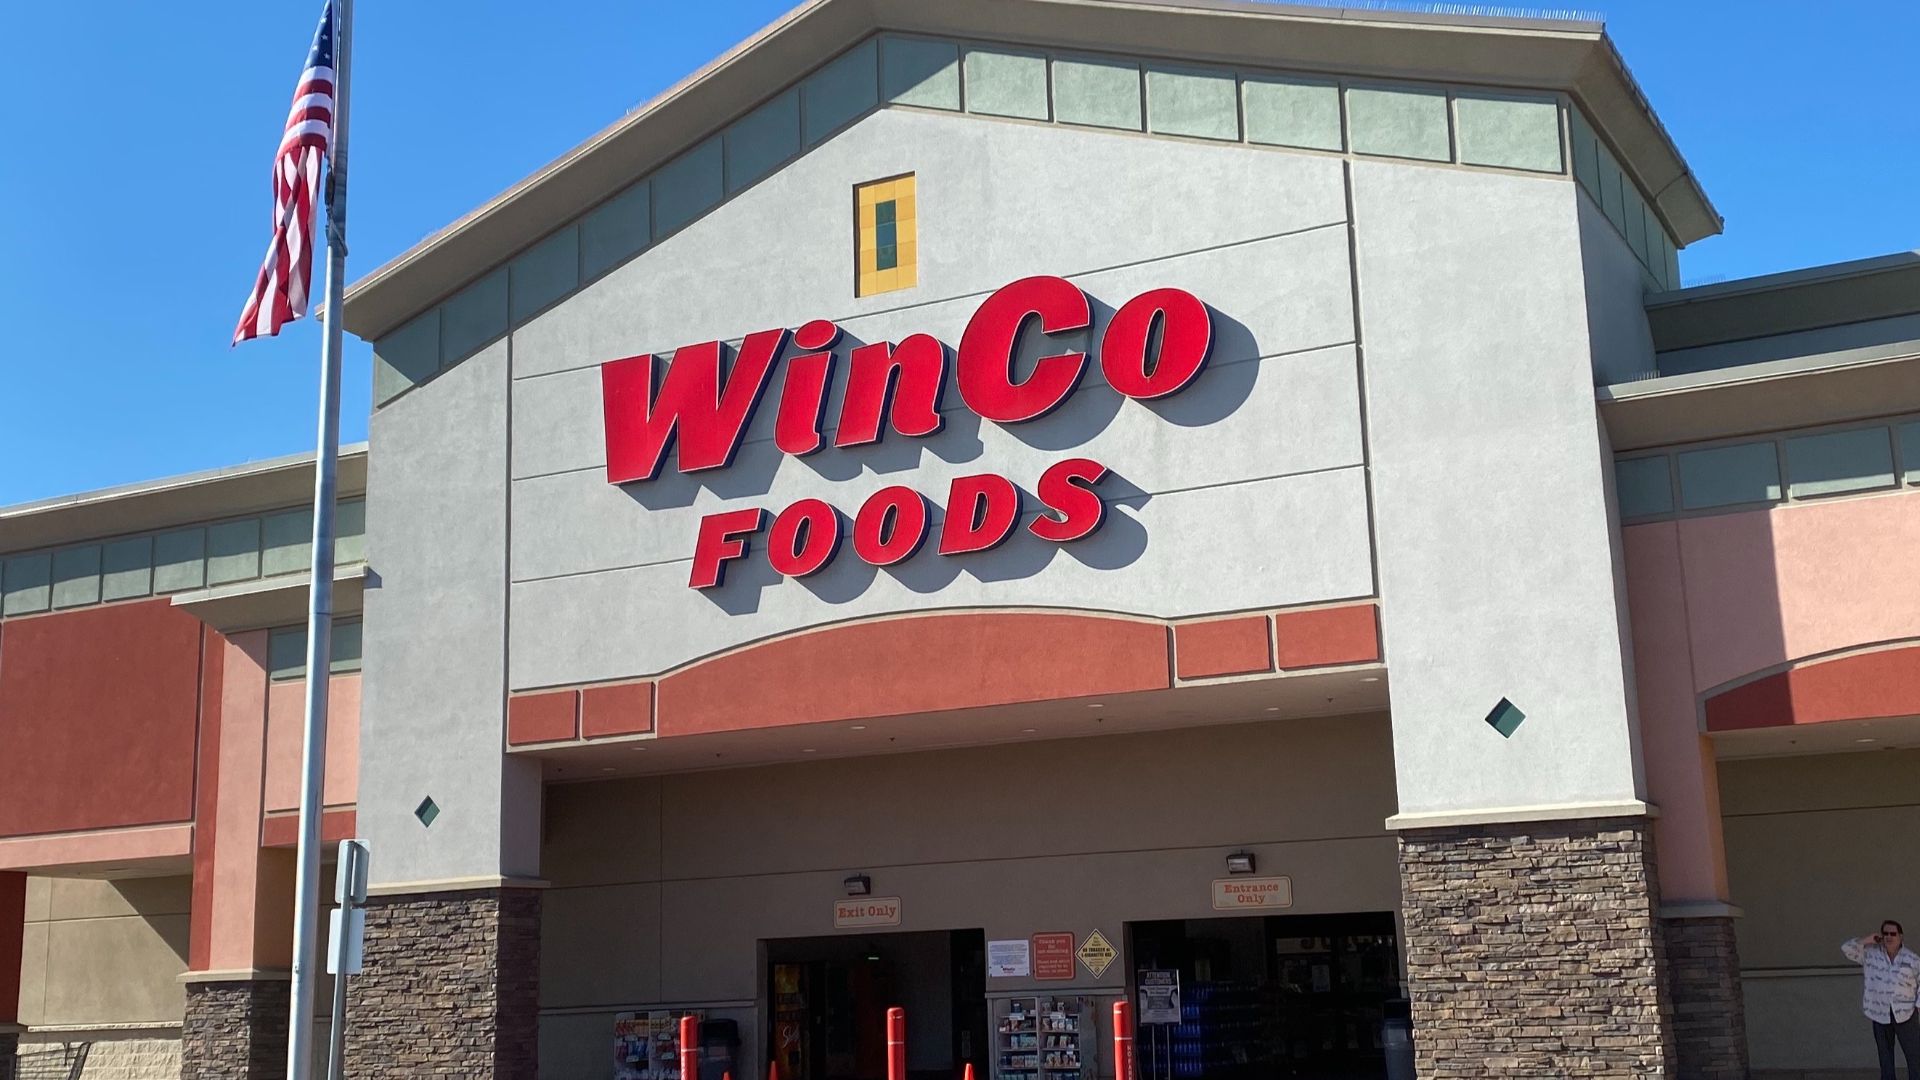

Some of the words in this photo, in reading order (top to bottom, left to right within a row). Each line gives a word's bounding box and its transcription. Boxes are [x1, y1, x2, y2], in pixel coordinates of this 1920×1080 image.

[601, 275, 1215, 485] WinCo
[688, 457, 1108, 589] FOODS
[1224, 883, 1279, 893] Entrance
[1237, 894, 1265, 904] Only
[838, 906, 865, 918] Exit
[868, 905, 896, 918] Only
